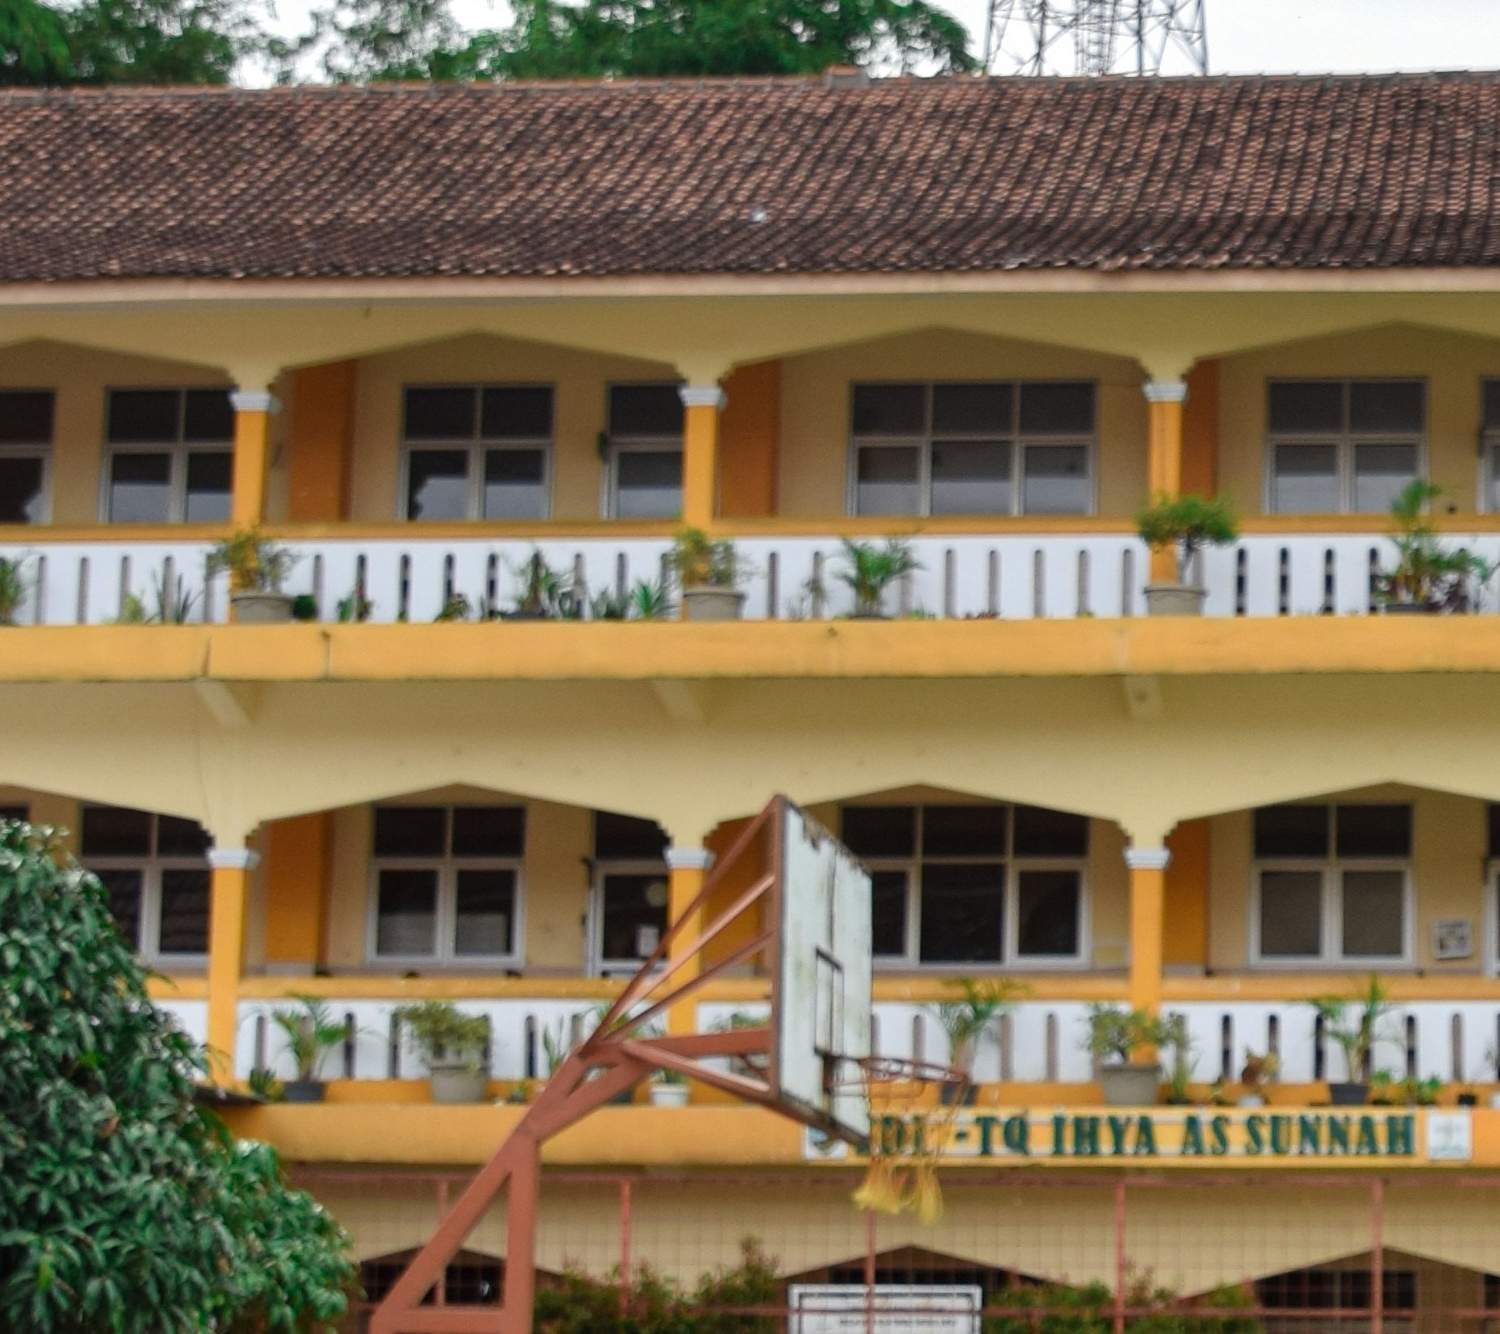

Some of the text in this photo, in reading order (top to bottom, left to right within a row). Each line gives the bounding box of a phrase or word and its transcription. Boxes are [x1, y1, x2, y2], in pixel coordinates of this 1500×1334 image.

[1052, 1115, 1158, 1156] IHYA
[1180, 1114, 1230, 1156] AS
[1244, 1113, 1417, 1156] SUNNAH
